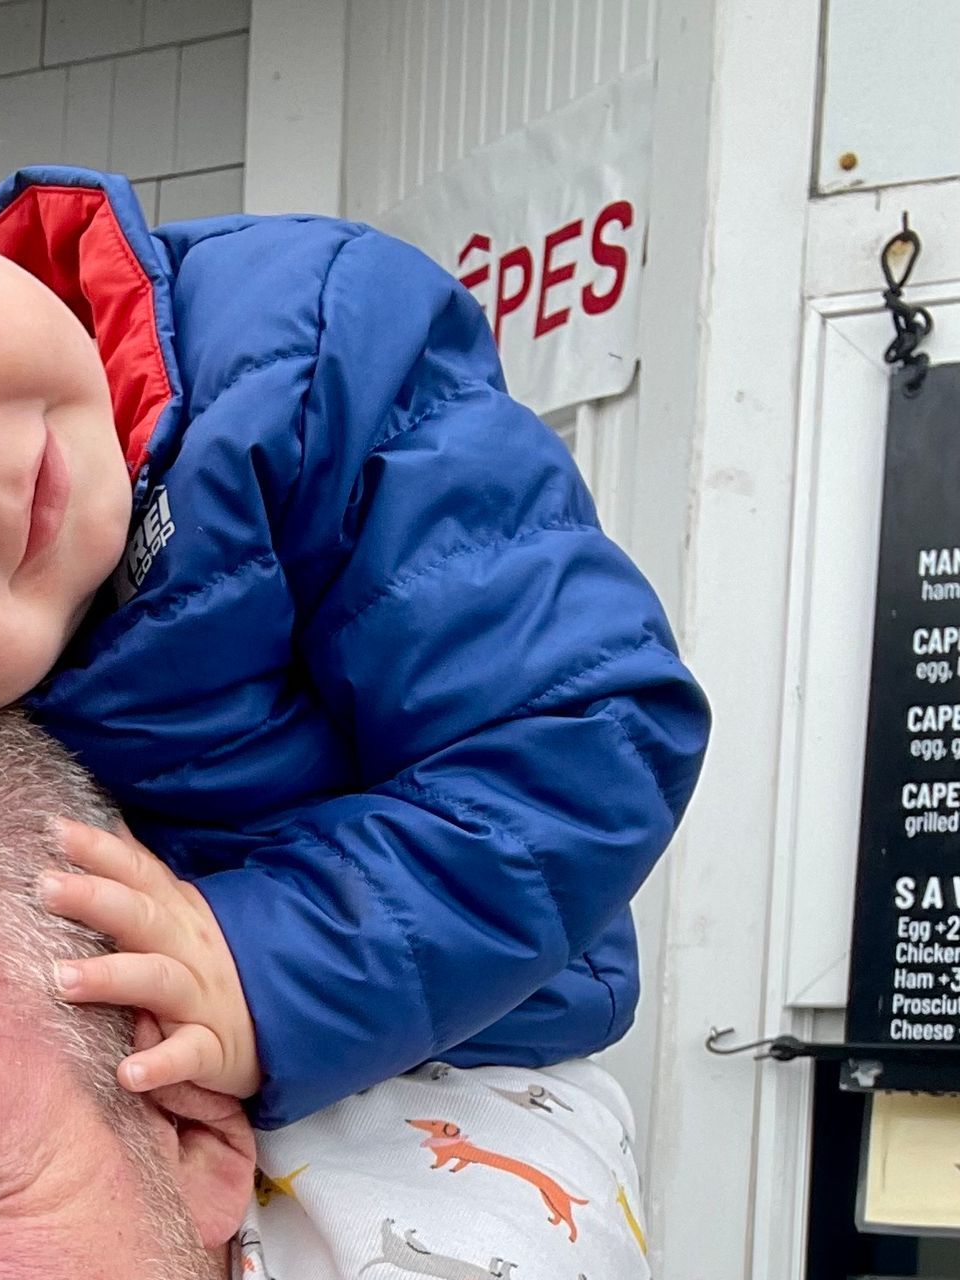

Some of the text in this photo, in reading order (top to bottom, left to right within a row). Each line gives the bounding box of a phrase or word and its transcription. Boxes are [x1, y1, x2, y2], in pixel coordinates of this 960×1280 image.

[128, 488, 171, 575] REI
[913, 627, 960, 655] CAP
[916, 660, 953, 684] egg,
[910, 738, 947, 761] egg,
[902, 782, 960, 810] CAPE
[904, 811, 959, 838] grilled
[897, 916, 931, 942] Egg
[894, 968, 934, 989] Ham
[892, 993, 960, 1015] Prosciu
[890, 1018, 955, 1041] Cheese
